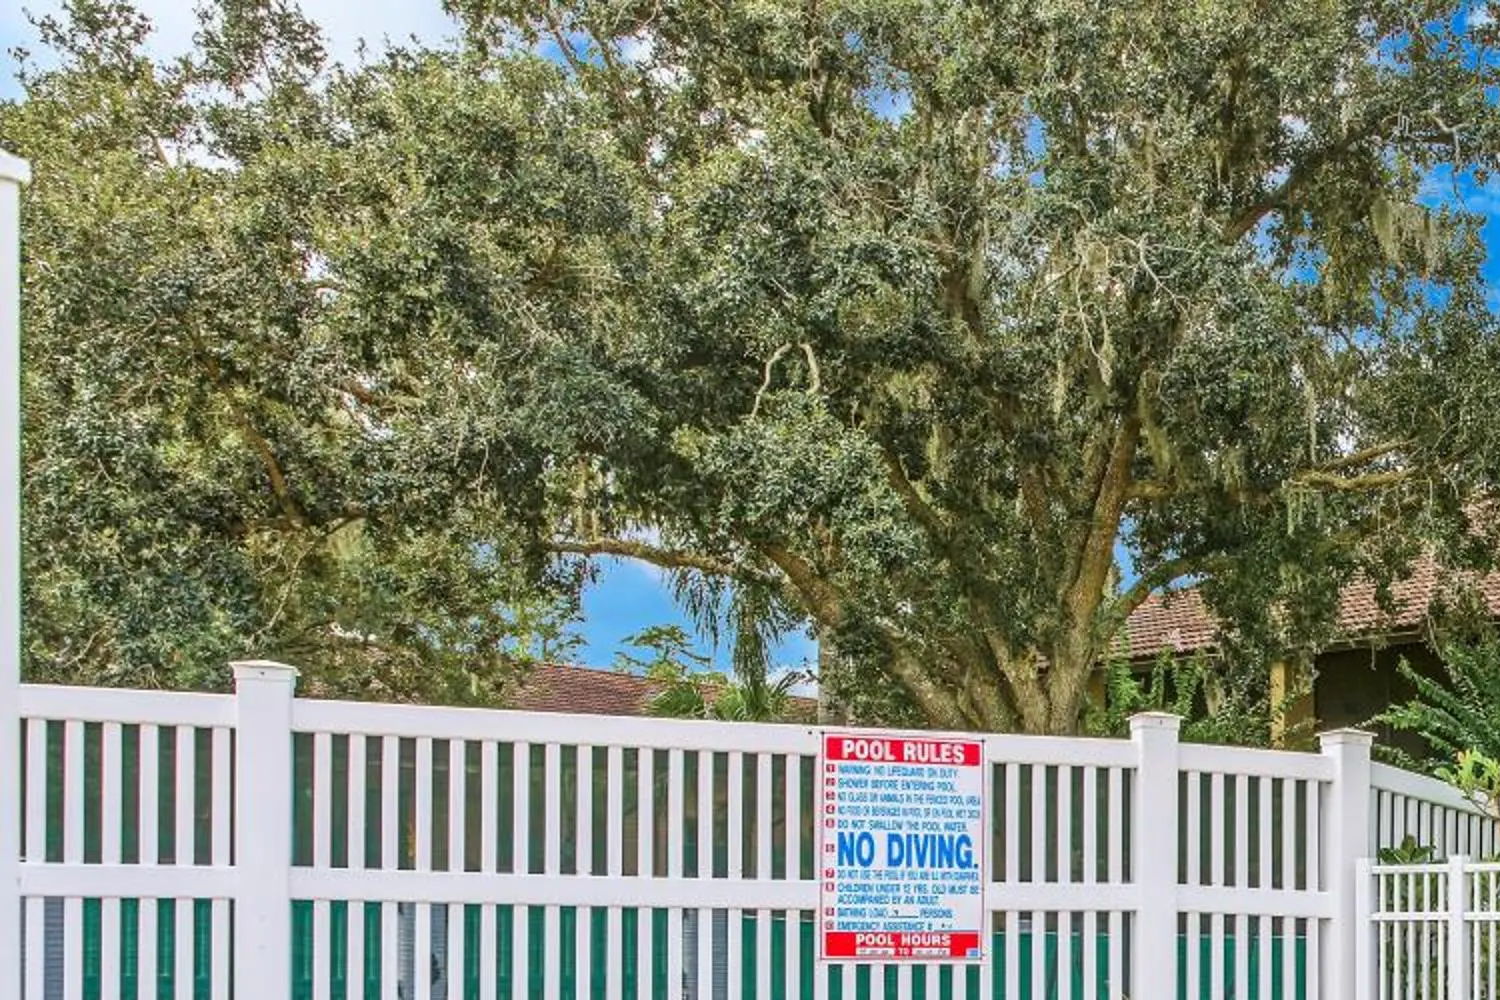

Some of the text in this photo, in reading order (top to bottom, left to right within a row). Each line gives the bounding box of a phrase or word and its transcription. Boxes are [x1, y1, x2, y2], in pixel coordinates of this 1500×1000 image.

[842, 740, 965, 763] POOL RULES
[874, 766, 884, 775] NO
[888, 767, 924, 776] LIFEGUARD
[928, 768, 938, 776] ON
[838, 778, 868, 789] SHOWER
[872, 780, 898, 790] BEFORE
[901, 781, 934, 791] ENTERING
[880, 794, 904, 803] ANIMALS
[914, 795, 924, 804] THE
[950, 796, 964, 805] POOL
[838, 819, 848, 829] DO
[852, 820, 865, 829] NOT
[869, 820, 903, 830] SWALLOW
[907, 821, 919, 830] THE
[923, 822, 942, 831] POOL
[838, 832, 979, 868] NO DIVING.
[838, 884, 873, 893] CHILDREN
[876, 884, 900, 893] UNDER
[931, 885, 946, 894] OLD
[948, 886, 966, 894] MUST
[969, 886, 979, 894] BE
[838, 894, 889, 904] ACCOMPANIED
[892, 895, 900, 904] BY
[904, 895, 915, 904] AN
[838, 908, 866, 918] BATHING
[870, 909, 888, 918] LOAD
[919, 909, 953, 918] PERSONS
[838, 921, 880, 930] EMERGENCY
[884, 922, 924, 930] ASSISTANCE
[856, 934, 951, 946] POOL HOURS
